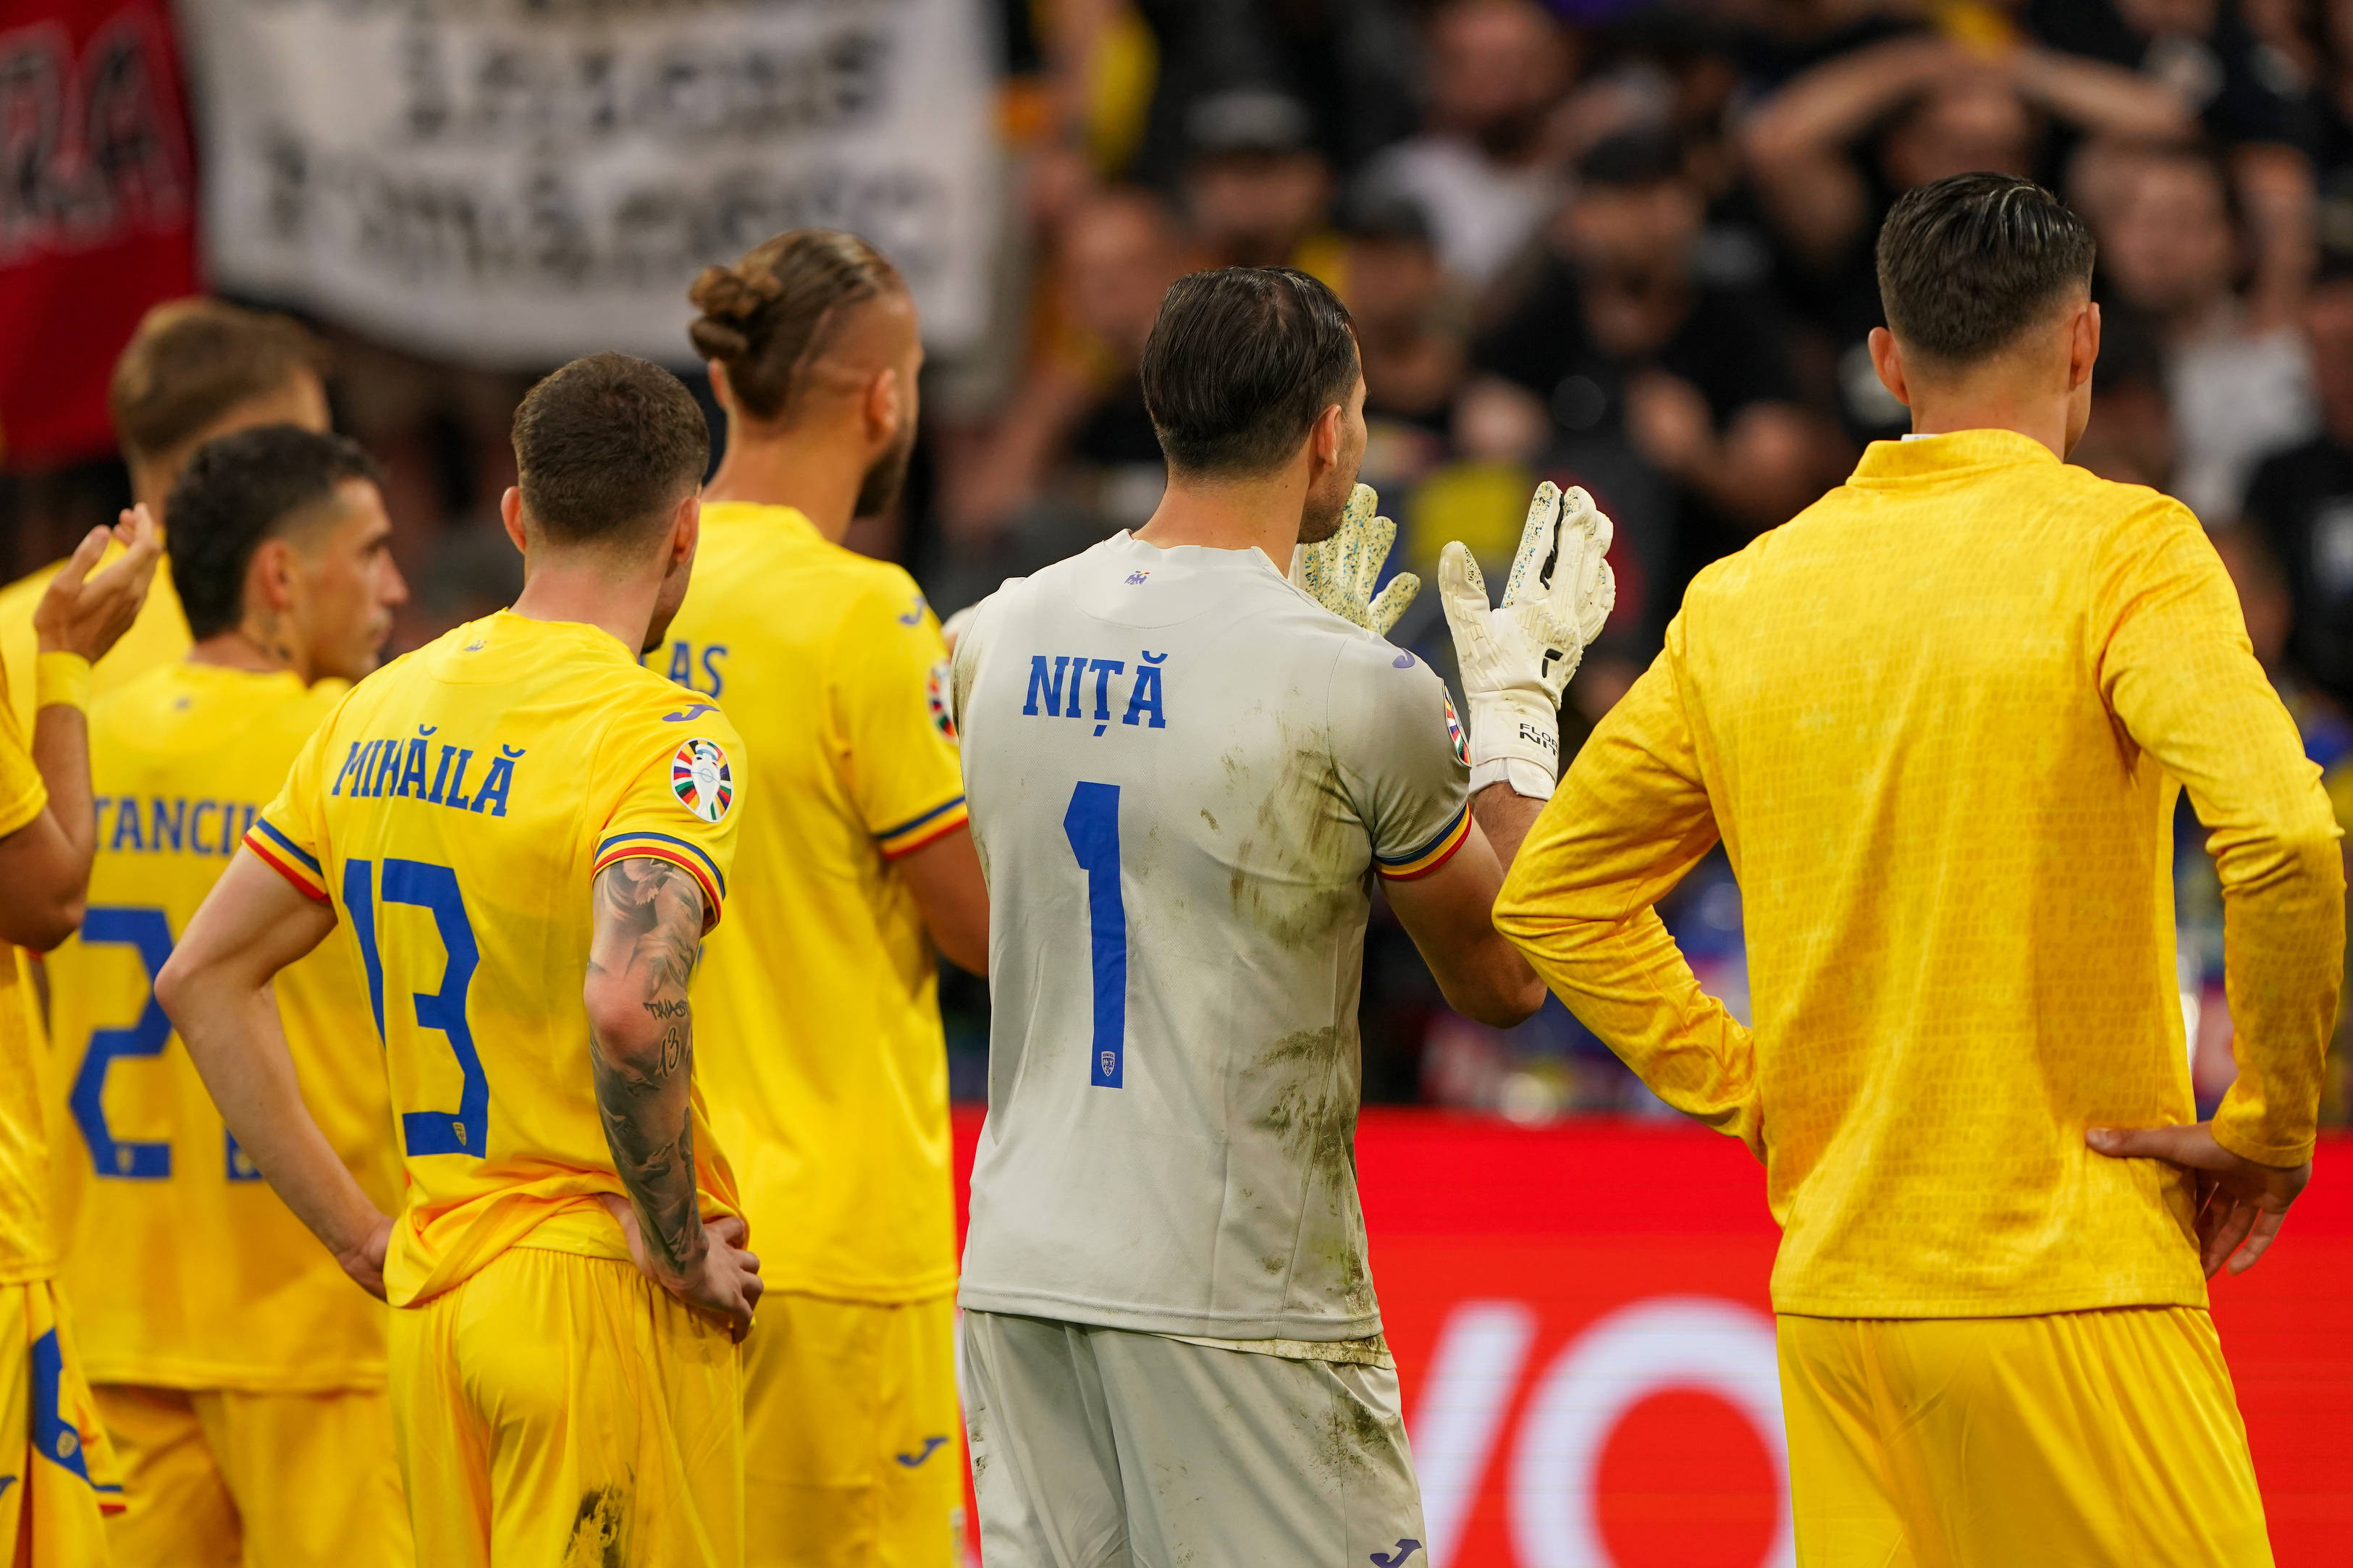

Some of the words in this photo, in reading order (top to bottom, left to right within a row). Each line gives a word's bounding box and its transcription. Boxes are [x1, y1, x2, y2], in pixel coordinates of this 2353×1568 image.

[639, 641, 728, 699] AS
[1022, 650, 1169, 737] NIȚĂ
[331, 723, 526, 817] MIHĂILĂ
[1063, 780, 1127, 1089] 1
[342, 857, 489, 1160] 13
